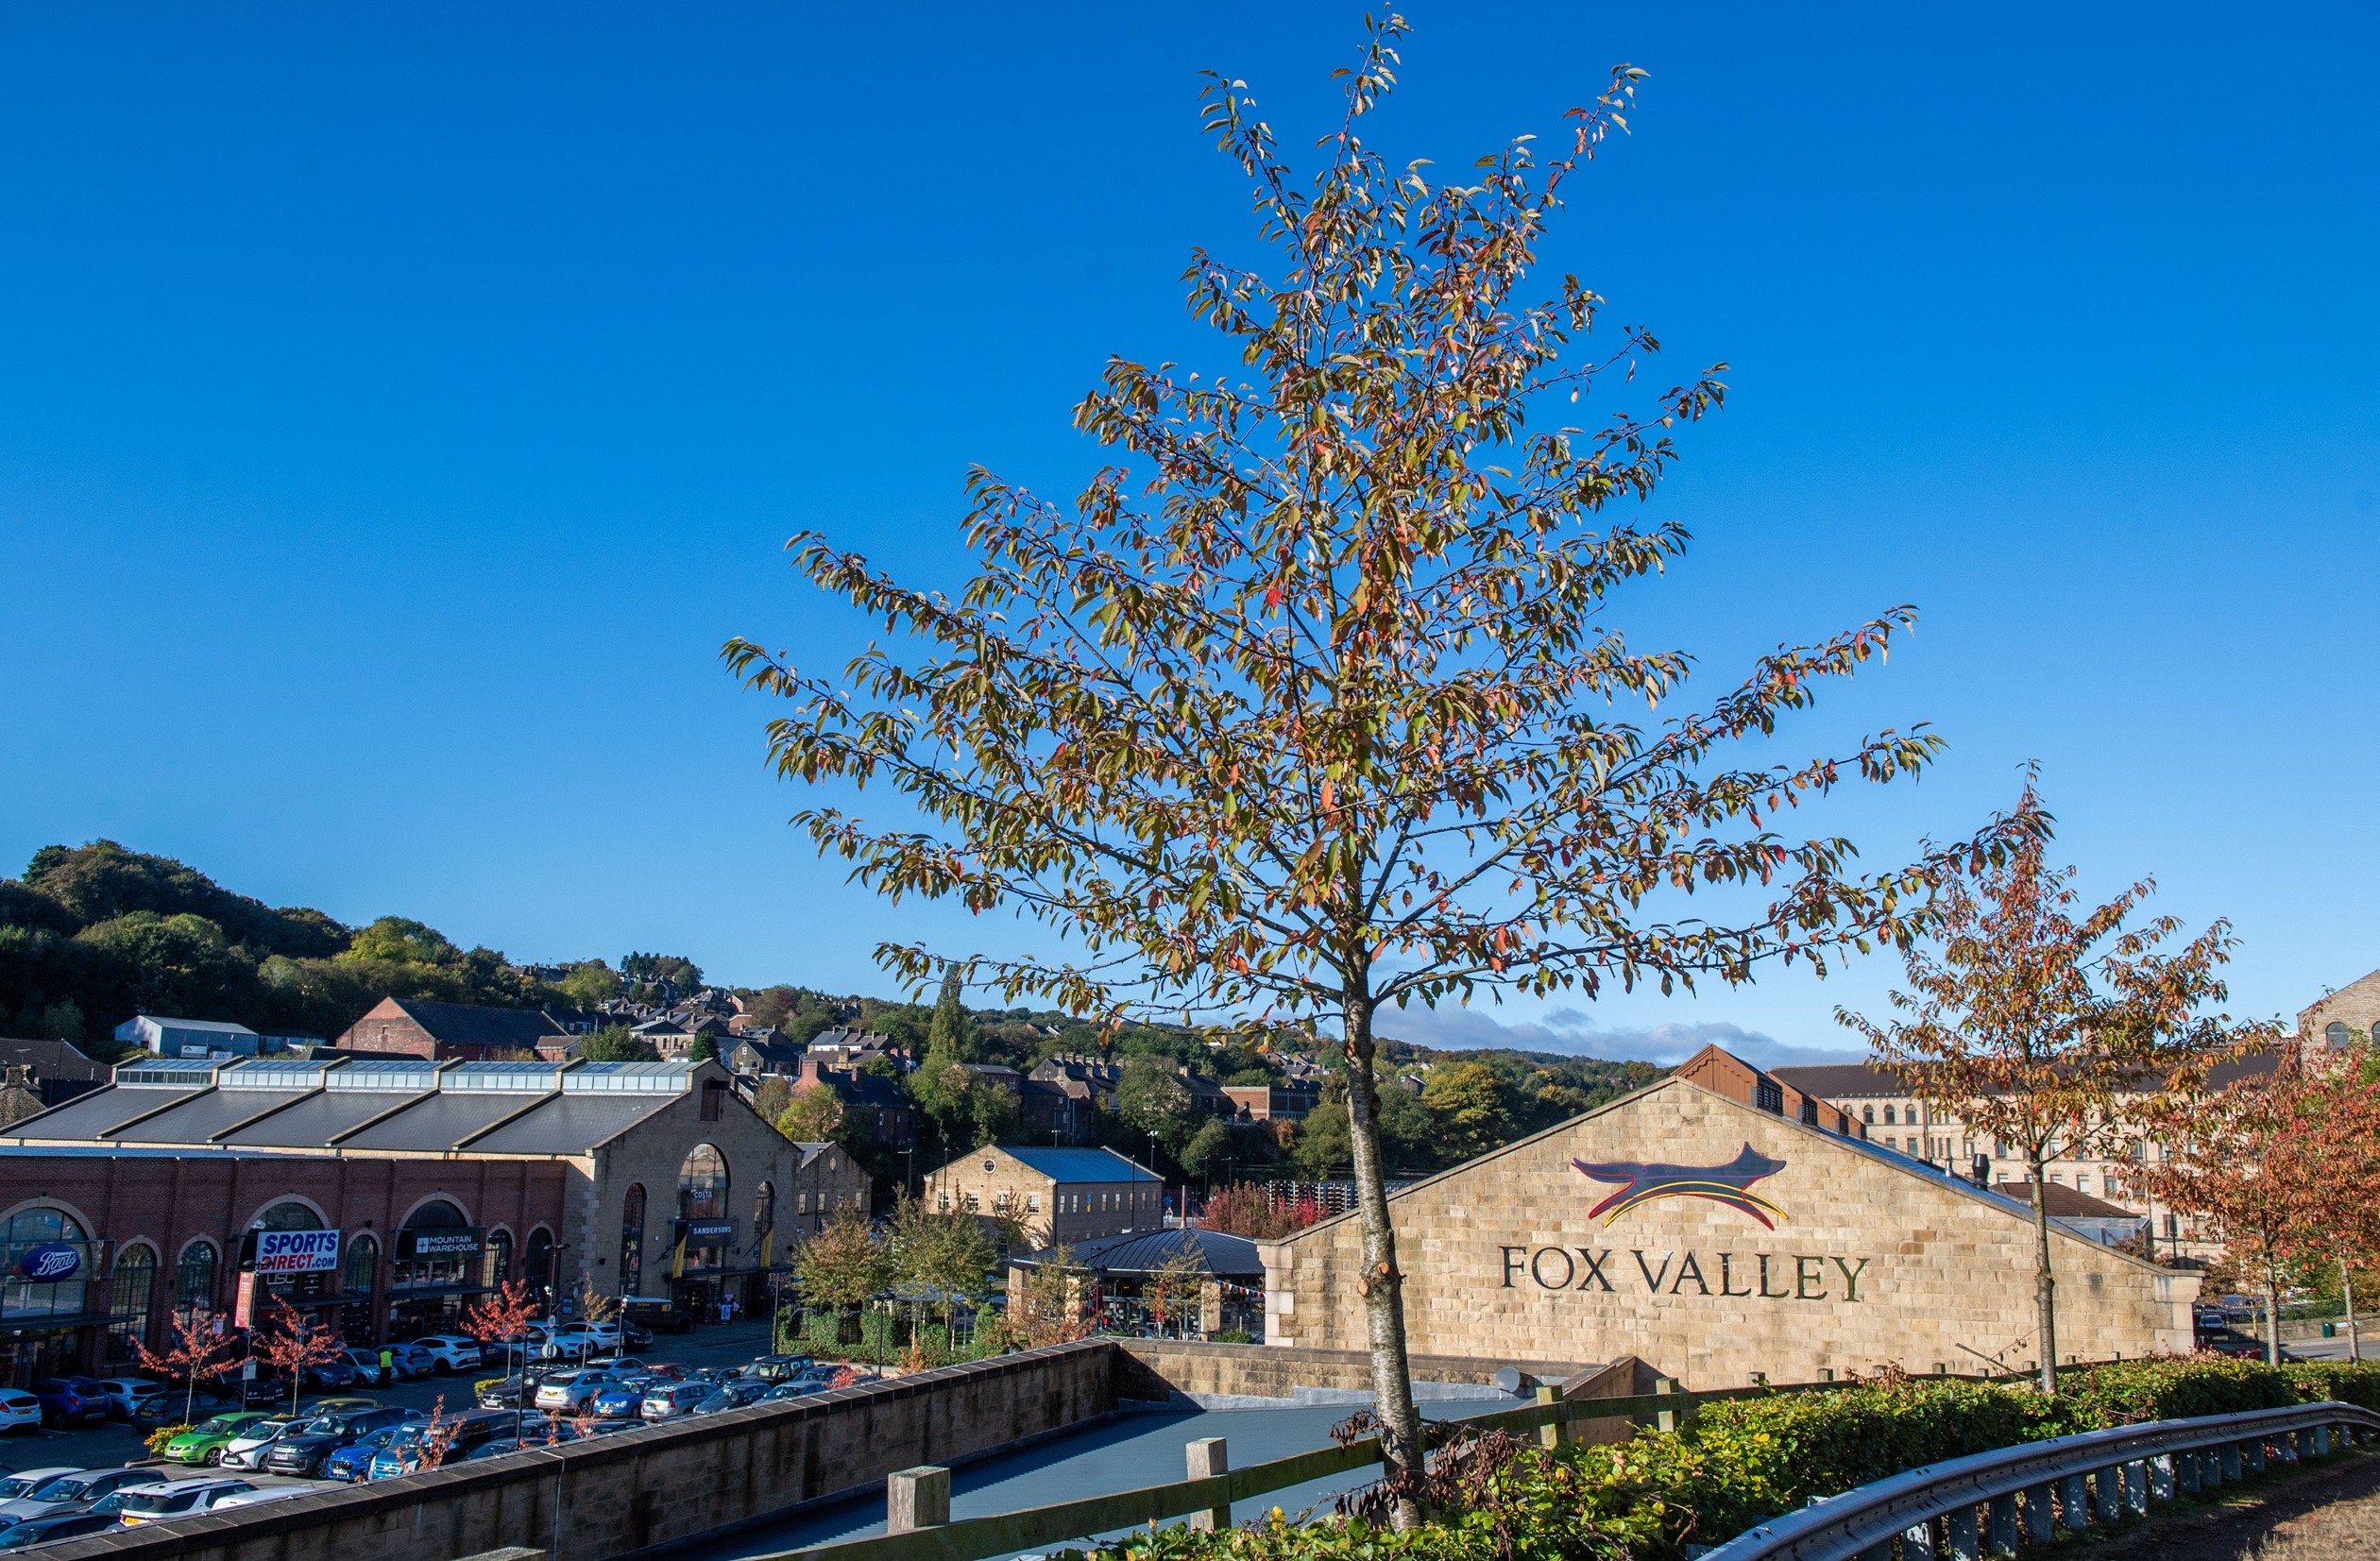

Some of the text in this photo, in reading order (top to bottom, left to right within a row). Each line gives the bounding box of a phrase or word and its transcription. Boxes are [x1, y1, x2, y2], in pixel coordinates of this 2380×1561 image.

[694, 1191, 712, 1199] COSTA
[692, 1226, 732, 1235] SANDERSONS
[263, 1232, 337, 1254] SPORTS
[429, 1235, 472, 1245] MOUNTAIN
[429, 1243, 479, 1253] WAREHOUSE
[31, 1251, 76, 1277] Boots
[266, 1272, 296, 1285] USC
[1498, 1246, 1870, 1302] FOX VALLEY
